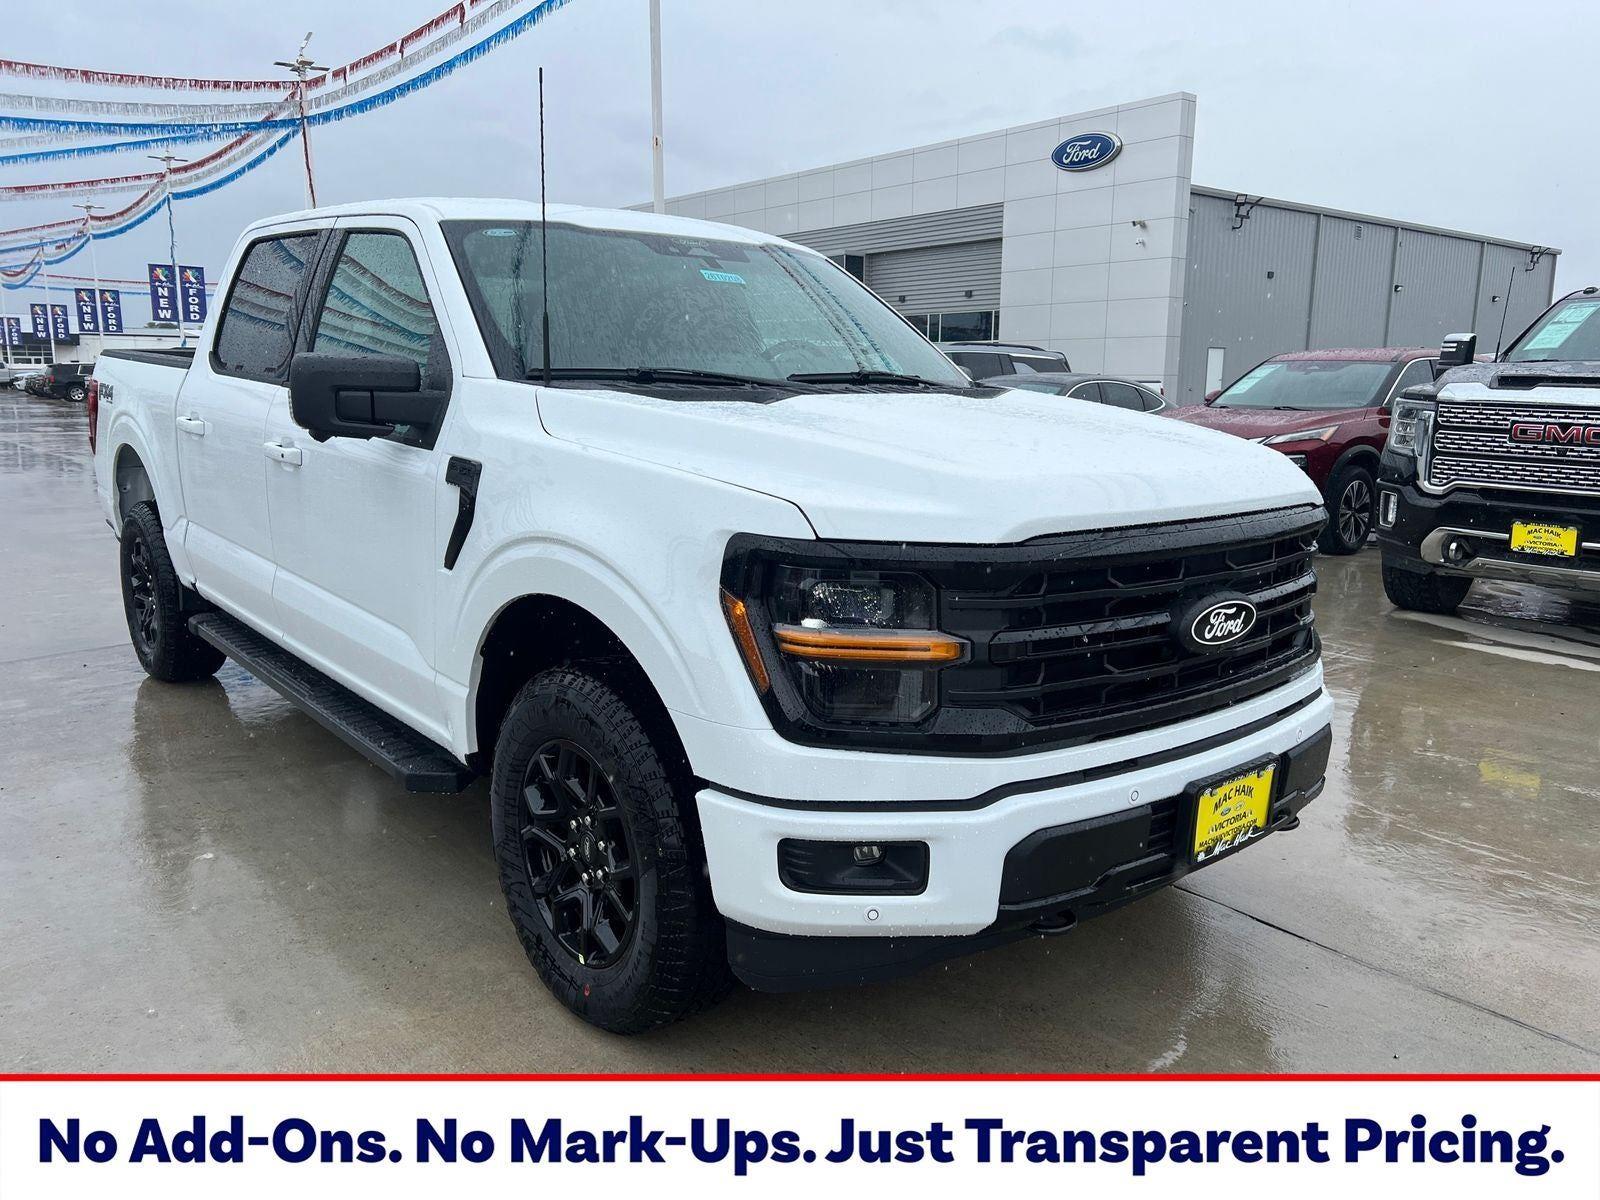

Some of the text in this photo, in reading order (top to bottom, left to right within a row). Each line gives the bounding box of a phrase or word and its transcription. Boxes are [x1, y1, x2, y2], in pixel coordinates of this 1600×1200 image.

[1063, 140, 1101, 164] Ford
[157, 287, 172, 319] NEW
[188, 289, 200, 320] FORD
[36, 317, 46, 338] NEW
[57, 318, 65, 339] FORD
[82, 305, 95, 330] NEW
[107, 306, 117, 331] FORD
[1527, 527, 1562, 538] MAC HAIK
[1204, 607, 1246, 639] Ford
[1213, 784, 1254, 814] MAC HAIK
[1214, 811, 1247, 833] VICTORIA
